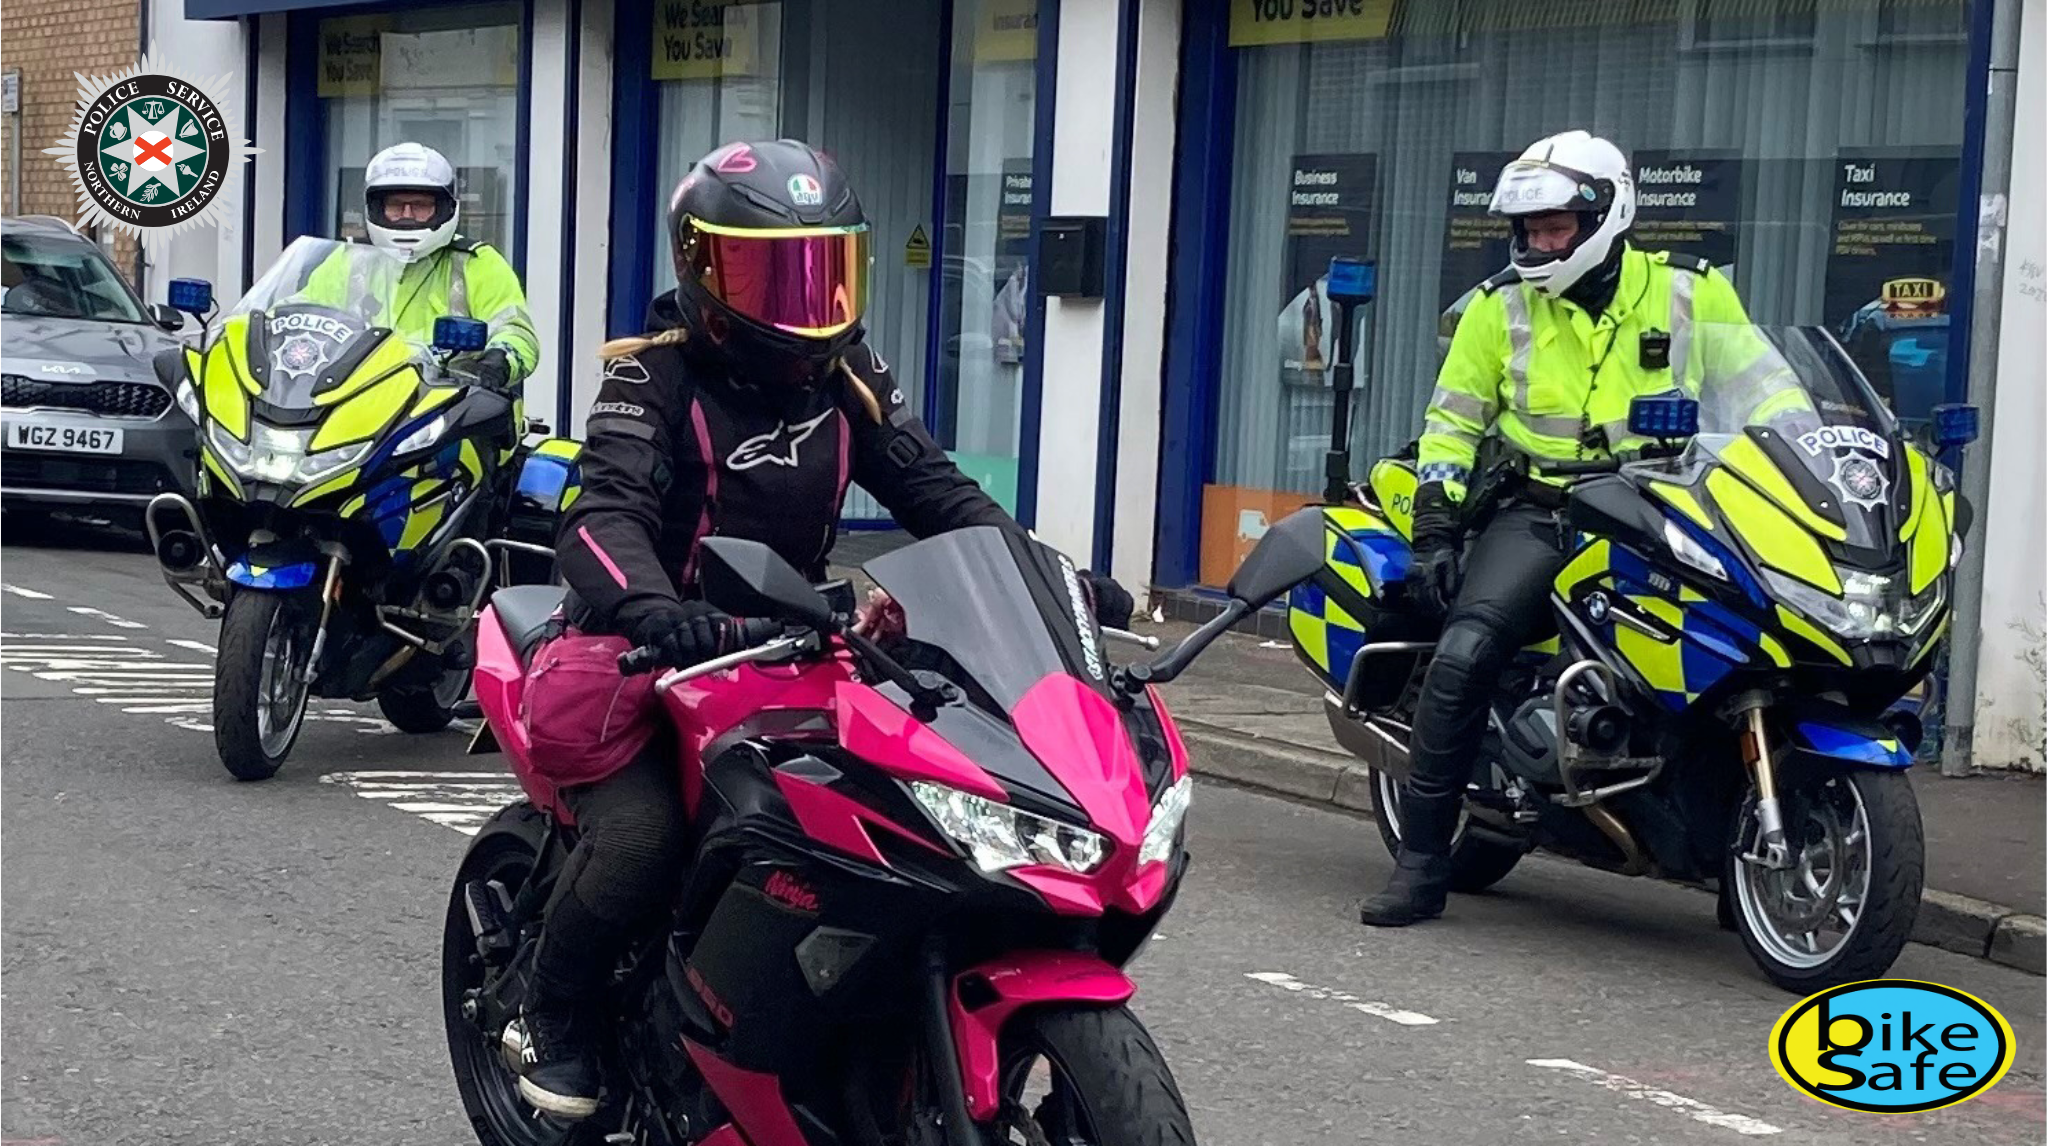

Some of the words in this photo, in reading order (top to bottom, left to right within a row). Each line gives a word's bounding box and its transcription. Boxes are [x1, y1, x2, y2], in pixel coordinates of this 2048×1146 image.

[665, 1, 688, 30] We
[664, 34, 691, 62] You
[694, 31, 732, 60] Save
[1295, 169, 1338, 186] Business
[1456, 168, 1477, 184] Van
[1639, 165, 1702, 184] Motorbike
[1844, 163, 1875, 183] Taxi
[1292, 190, 1339, 206] Insurance
[1637, 190, 1697, 206] Insurance
[1841, 188, 1911, 207] Insurance
[1894, 283, 1929, 298] TAXI
[274, 315, 350, 342] POLICE
[18, 425, 57, 447] WGZ
[62, 428, 115, 450] 9467
[1802, 428, 1886, 454] POLICE
[1392, 493, 1415, 518] PO
[765, 870, 819, 910] Ninja
